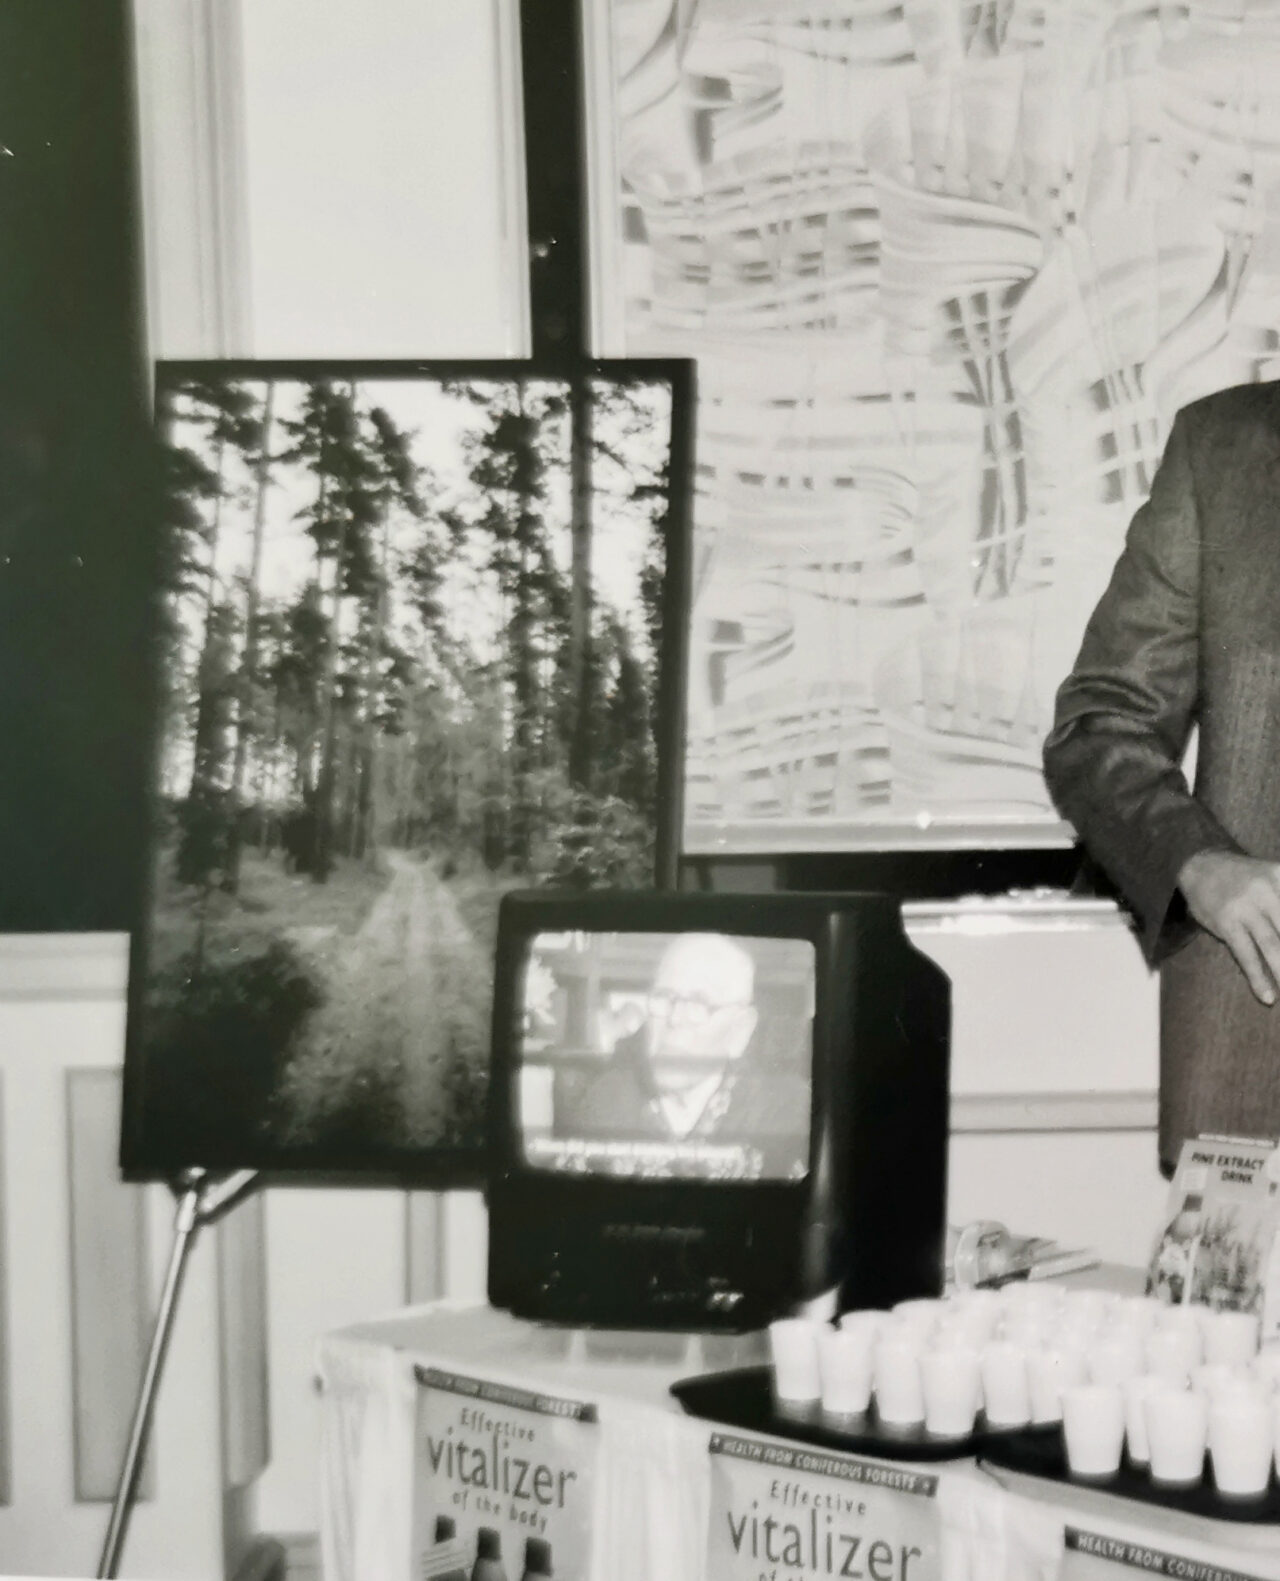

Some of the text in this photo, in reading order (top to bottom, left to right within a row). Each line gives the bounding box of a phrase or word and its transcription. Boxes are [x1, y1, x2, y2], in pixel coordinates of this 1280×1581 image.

[1191, 1151, 1265, 1171] PINE EXTRACT
[1221, 1169, 1254, 1185] DRINK
[460, 1407, 536, 1442] Effective
[427, 1425, 578, 1508] vitalizer
[764, 1447, 794, 1465] FROM
[795, 1453, 862, 1479] CONIFEROUS
[865, 1467, 917, 1490] FORESTS
[452, 1489, 548, 1534] of the body
[770, 1479, 867, 1515] Effective
[727, 1499, 922, 1581] vitalizer
[1078, 1535, 1126, 1558] HEALTH
[1128, 1547, 1164, 1569] FROM
